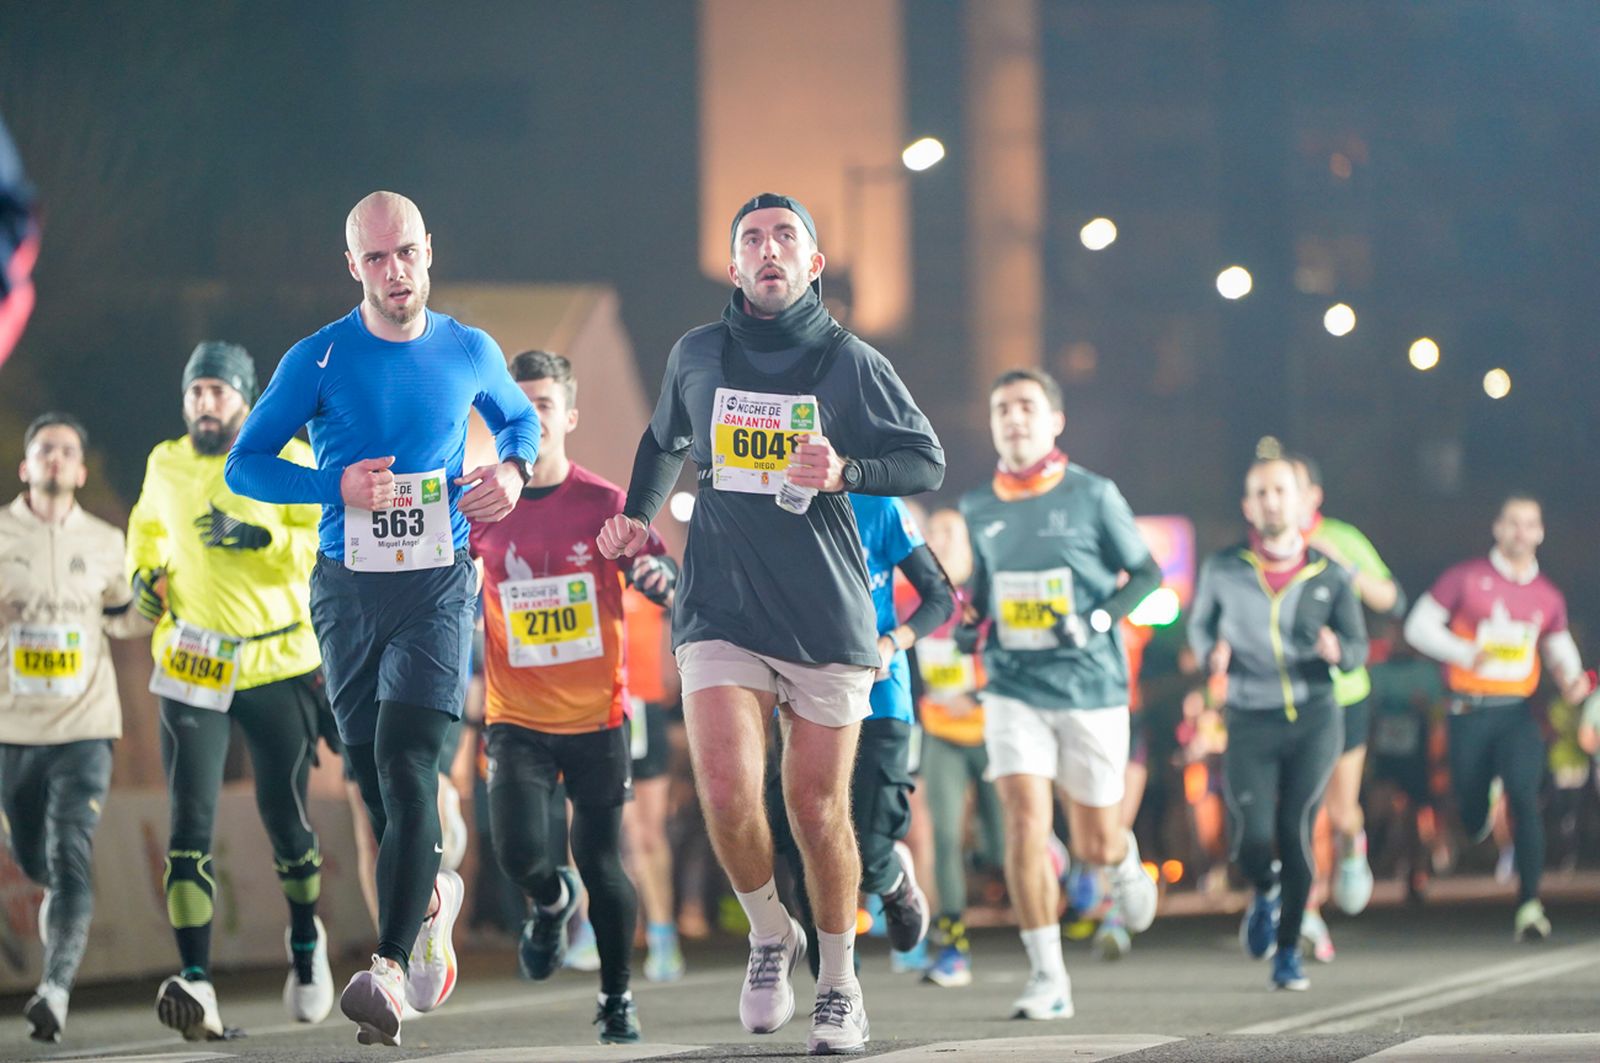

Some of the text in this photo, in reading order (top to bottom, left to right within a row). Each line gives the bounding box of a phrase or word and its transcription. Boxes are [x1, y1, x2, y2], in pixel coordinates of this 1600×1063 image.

[737, 404, 781, 416] NOCHE DE
[724, 413, 743, 426] SAN
[745, 415, 781, 429] ANTÓN
[754, 461, 776, 470] DIEGO
[400, 485, 412, 495] DE
[392, 494, 413, 508] TÓN
[372, 508, 425, 539] 563
[378, 540, 401, 549] Miguel
[525, 607, 577, 636] 2710
